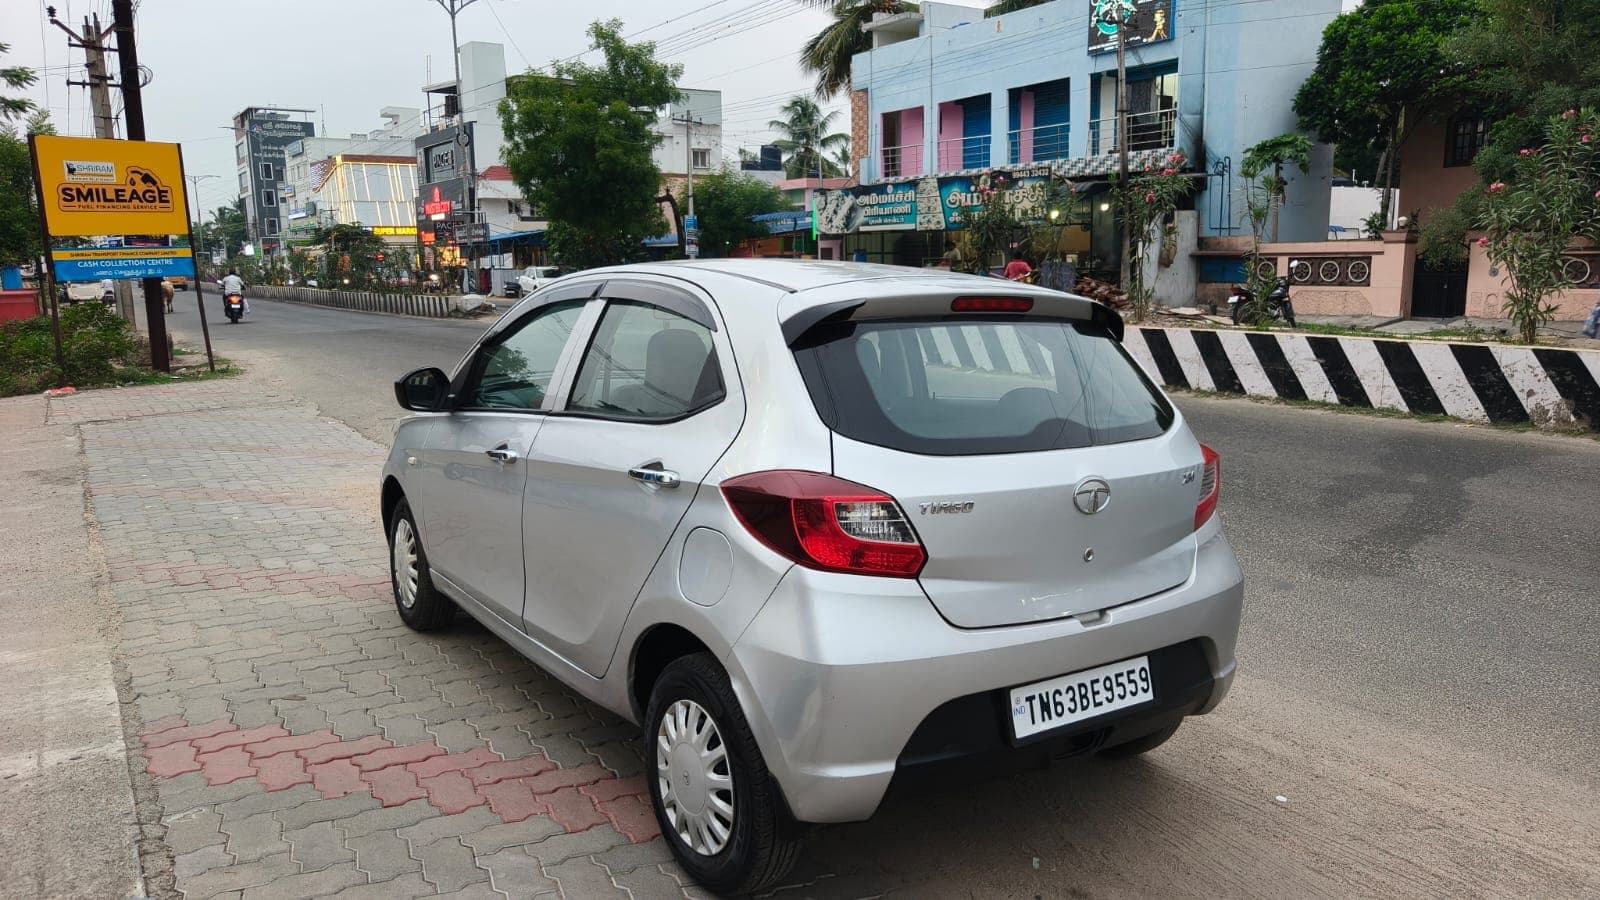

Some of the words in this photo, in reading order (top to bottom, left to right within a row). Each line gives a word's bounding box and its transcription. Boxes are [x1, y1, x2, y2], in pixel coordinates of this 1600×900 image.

[76, 164, 113, 173] SHRIRAM
[61, 187, 170, 203] SMILEAGE
[77, 260, 99, 268] CASH
[100, 259, 145, 268] COLLECTION
[147, 258, 174, 266] CENTRE
[1025, 666, 1150, 725] TN63BE9559
[1013, 705, 1026, 716] IND
